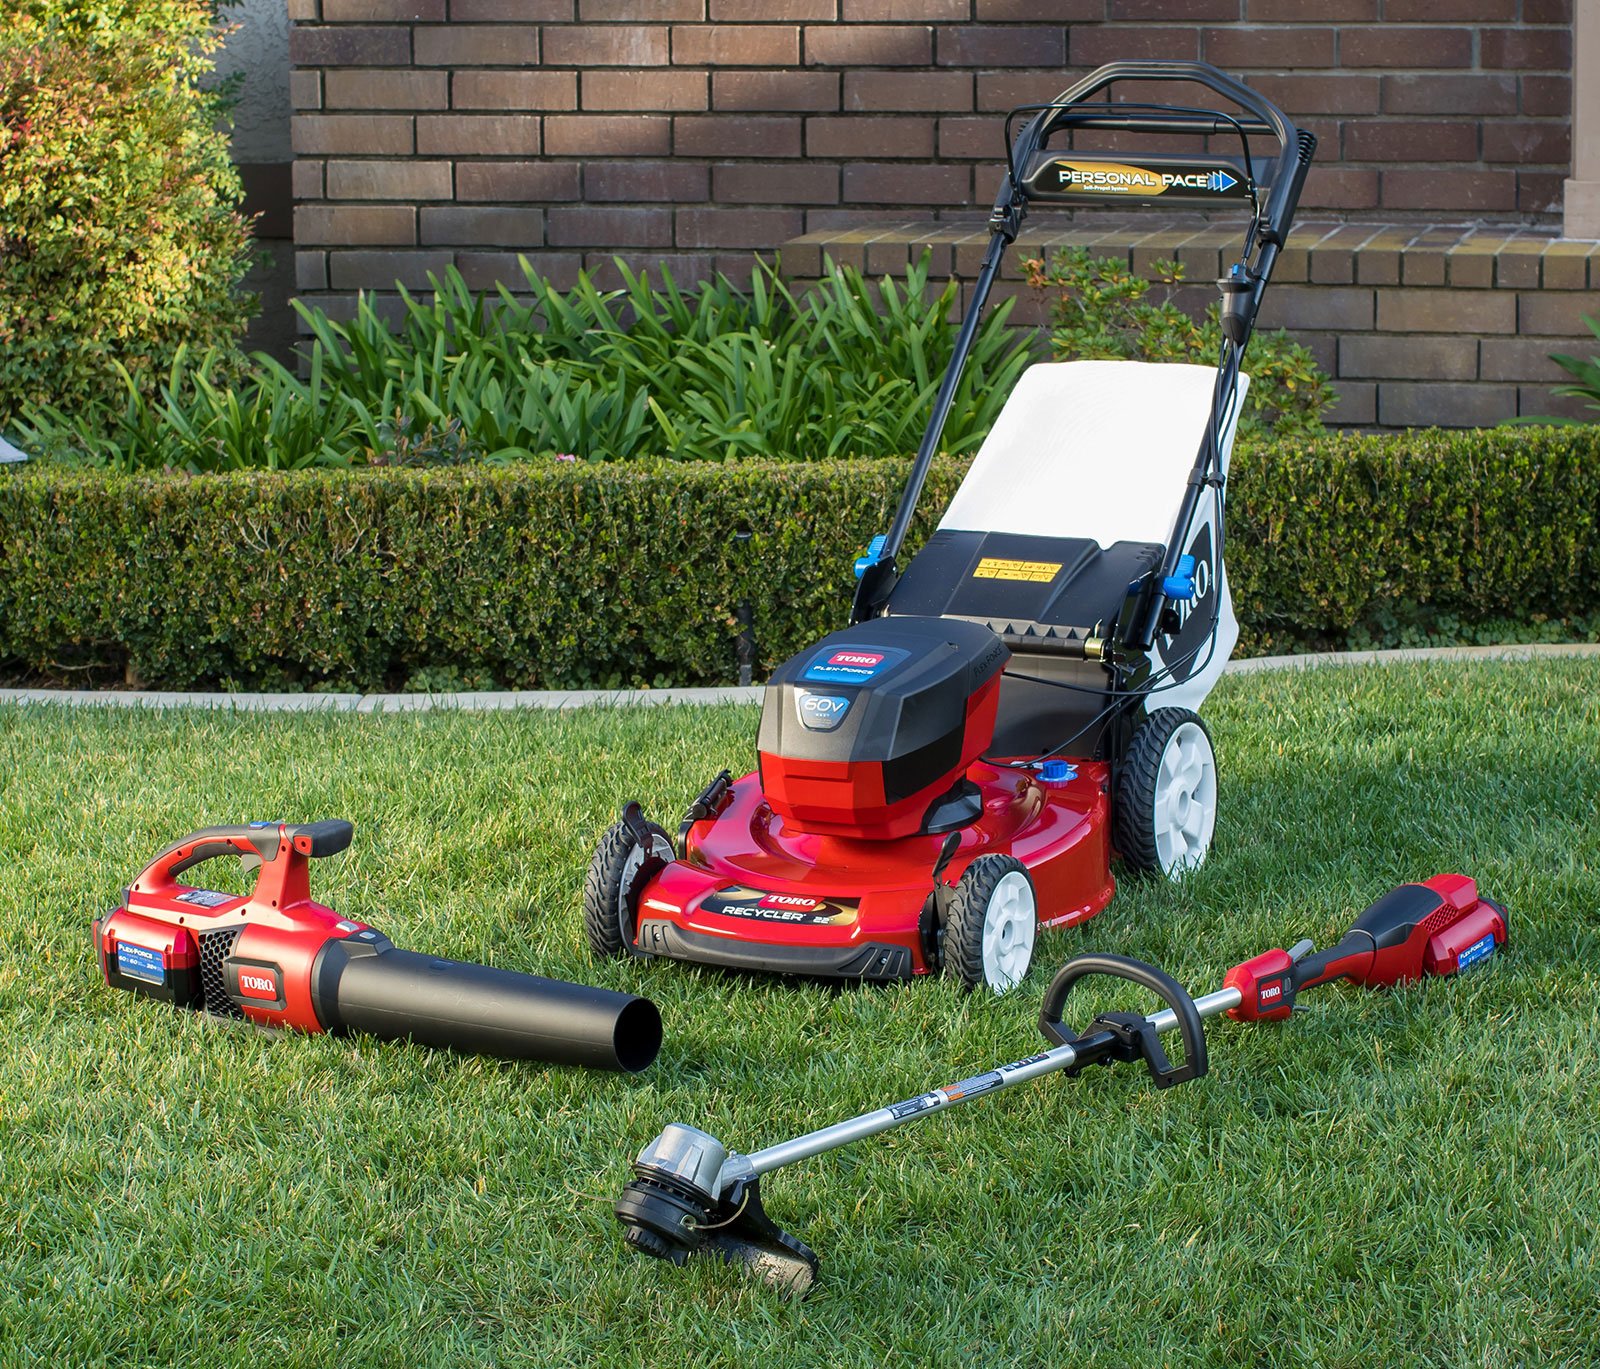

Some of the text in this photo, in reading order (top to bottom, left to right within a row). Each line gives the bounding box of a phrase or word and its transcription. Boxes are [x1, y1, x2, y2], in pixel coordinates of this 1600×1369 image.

[1059, 171, 1208, 188] PERSONAL PACE
[837, 655, 878, 664] TORO
[813, 665, 875, 675] FLEX-FORCE
[804, 698, 845, 712] 60V
[768, 895, 817, 906] TORO
[722, 906, 803, 921] RECYCLER
[1260, 986, 1280, 1000] TORO
